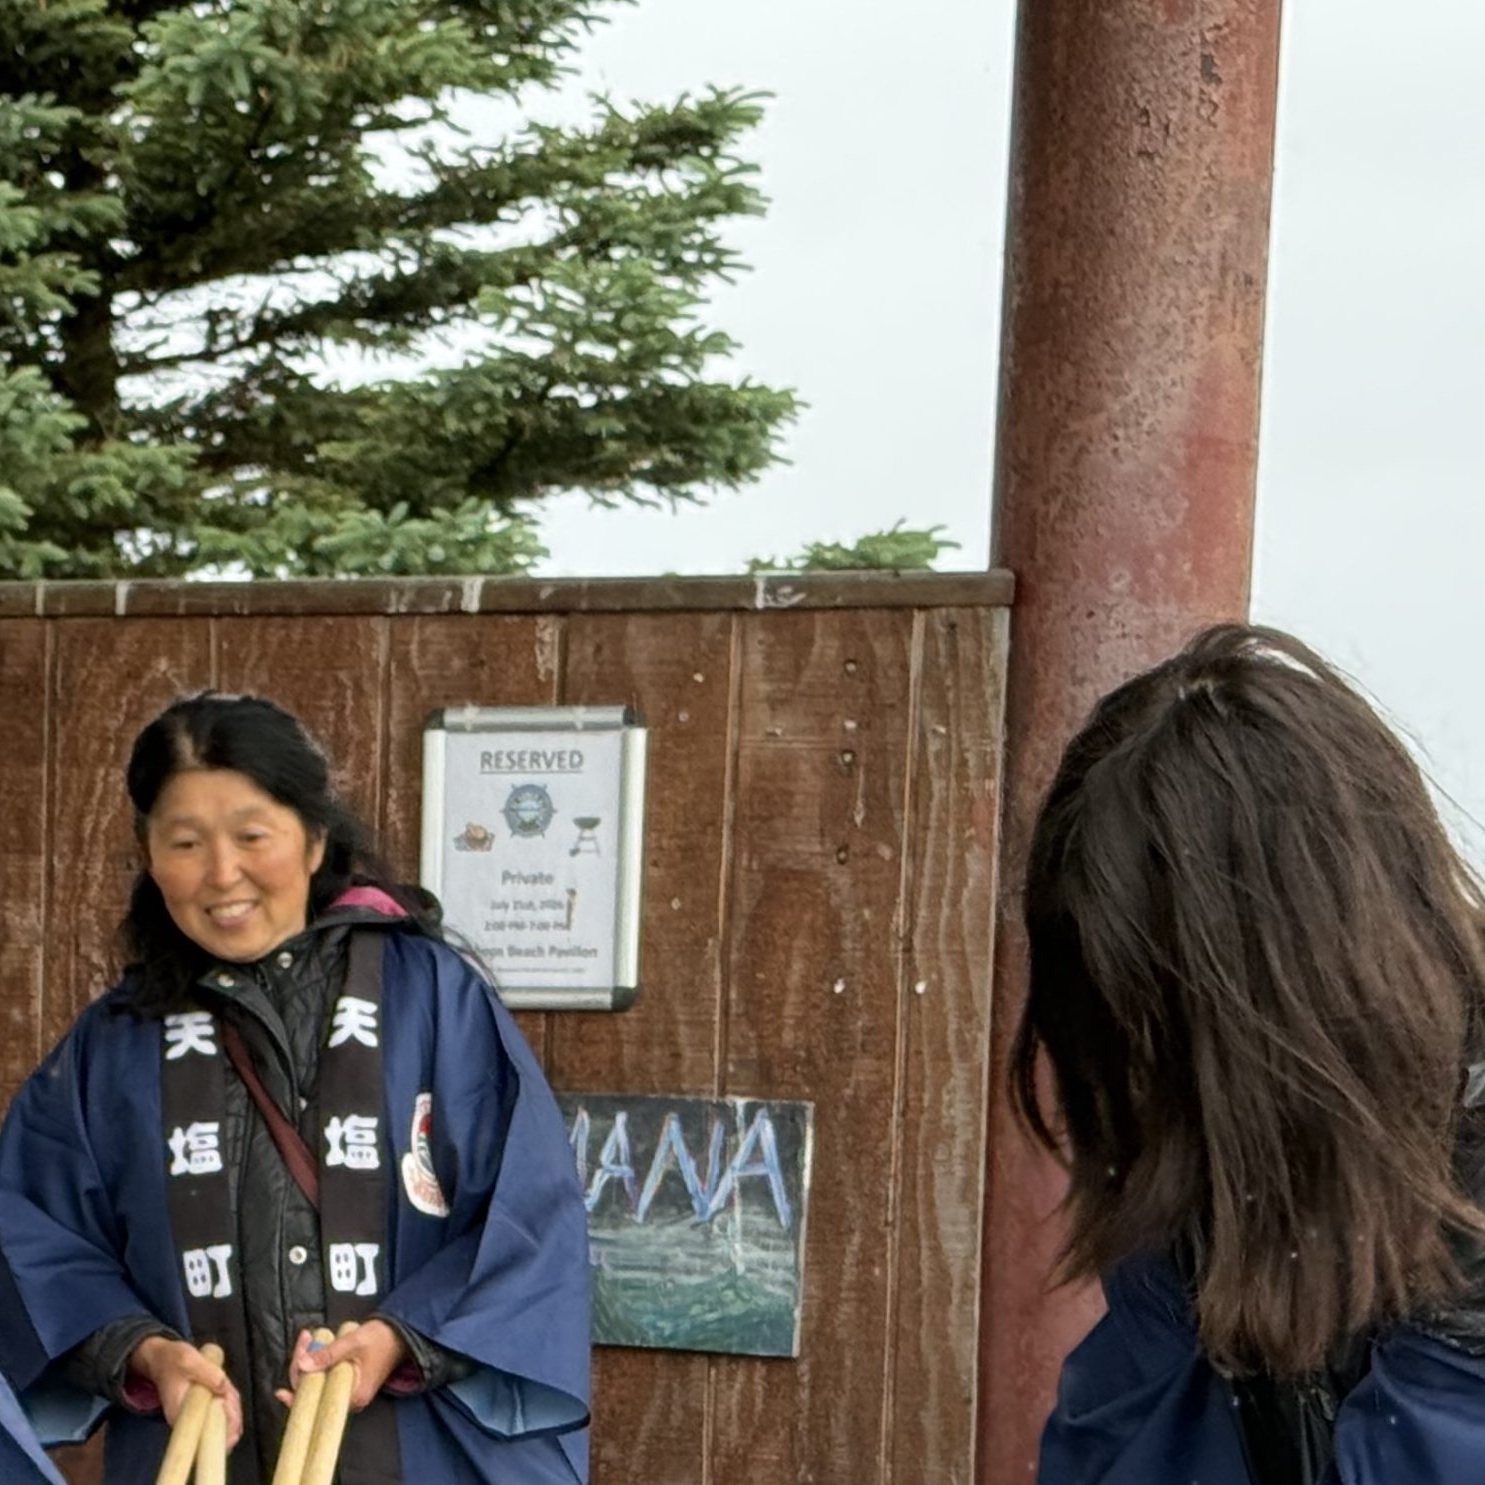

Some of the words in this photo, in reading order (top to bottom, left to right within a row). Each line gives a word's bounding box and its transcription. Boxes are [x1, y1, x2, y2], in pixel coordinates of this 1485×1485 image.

[480, 749, 584, 774] RESERVED
[501, 869, 554, 886] Private
[507, 945, 545, 957] Beach
[548, 945, 598, 957] Pavilion
[165, 1010, 233, 1299] 天塩町
[324, 996, 381, 1296] 天塩町
